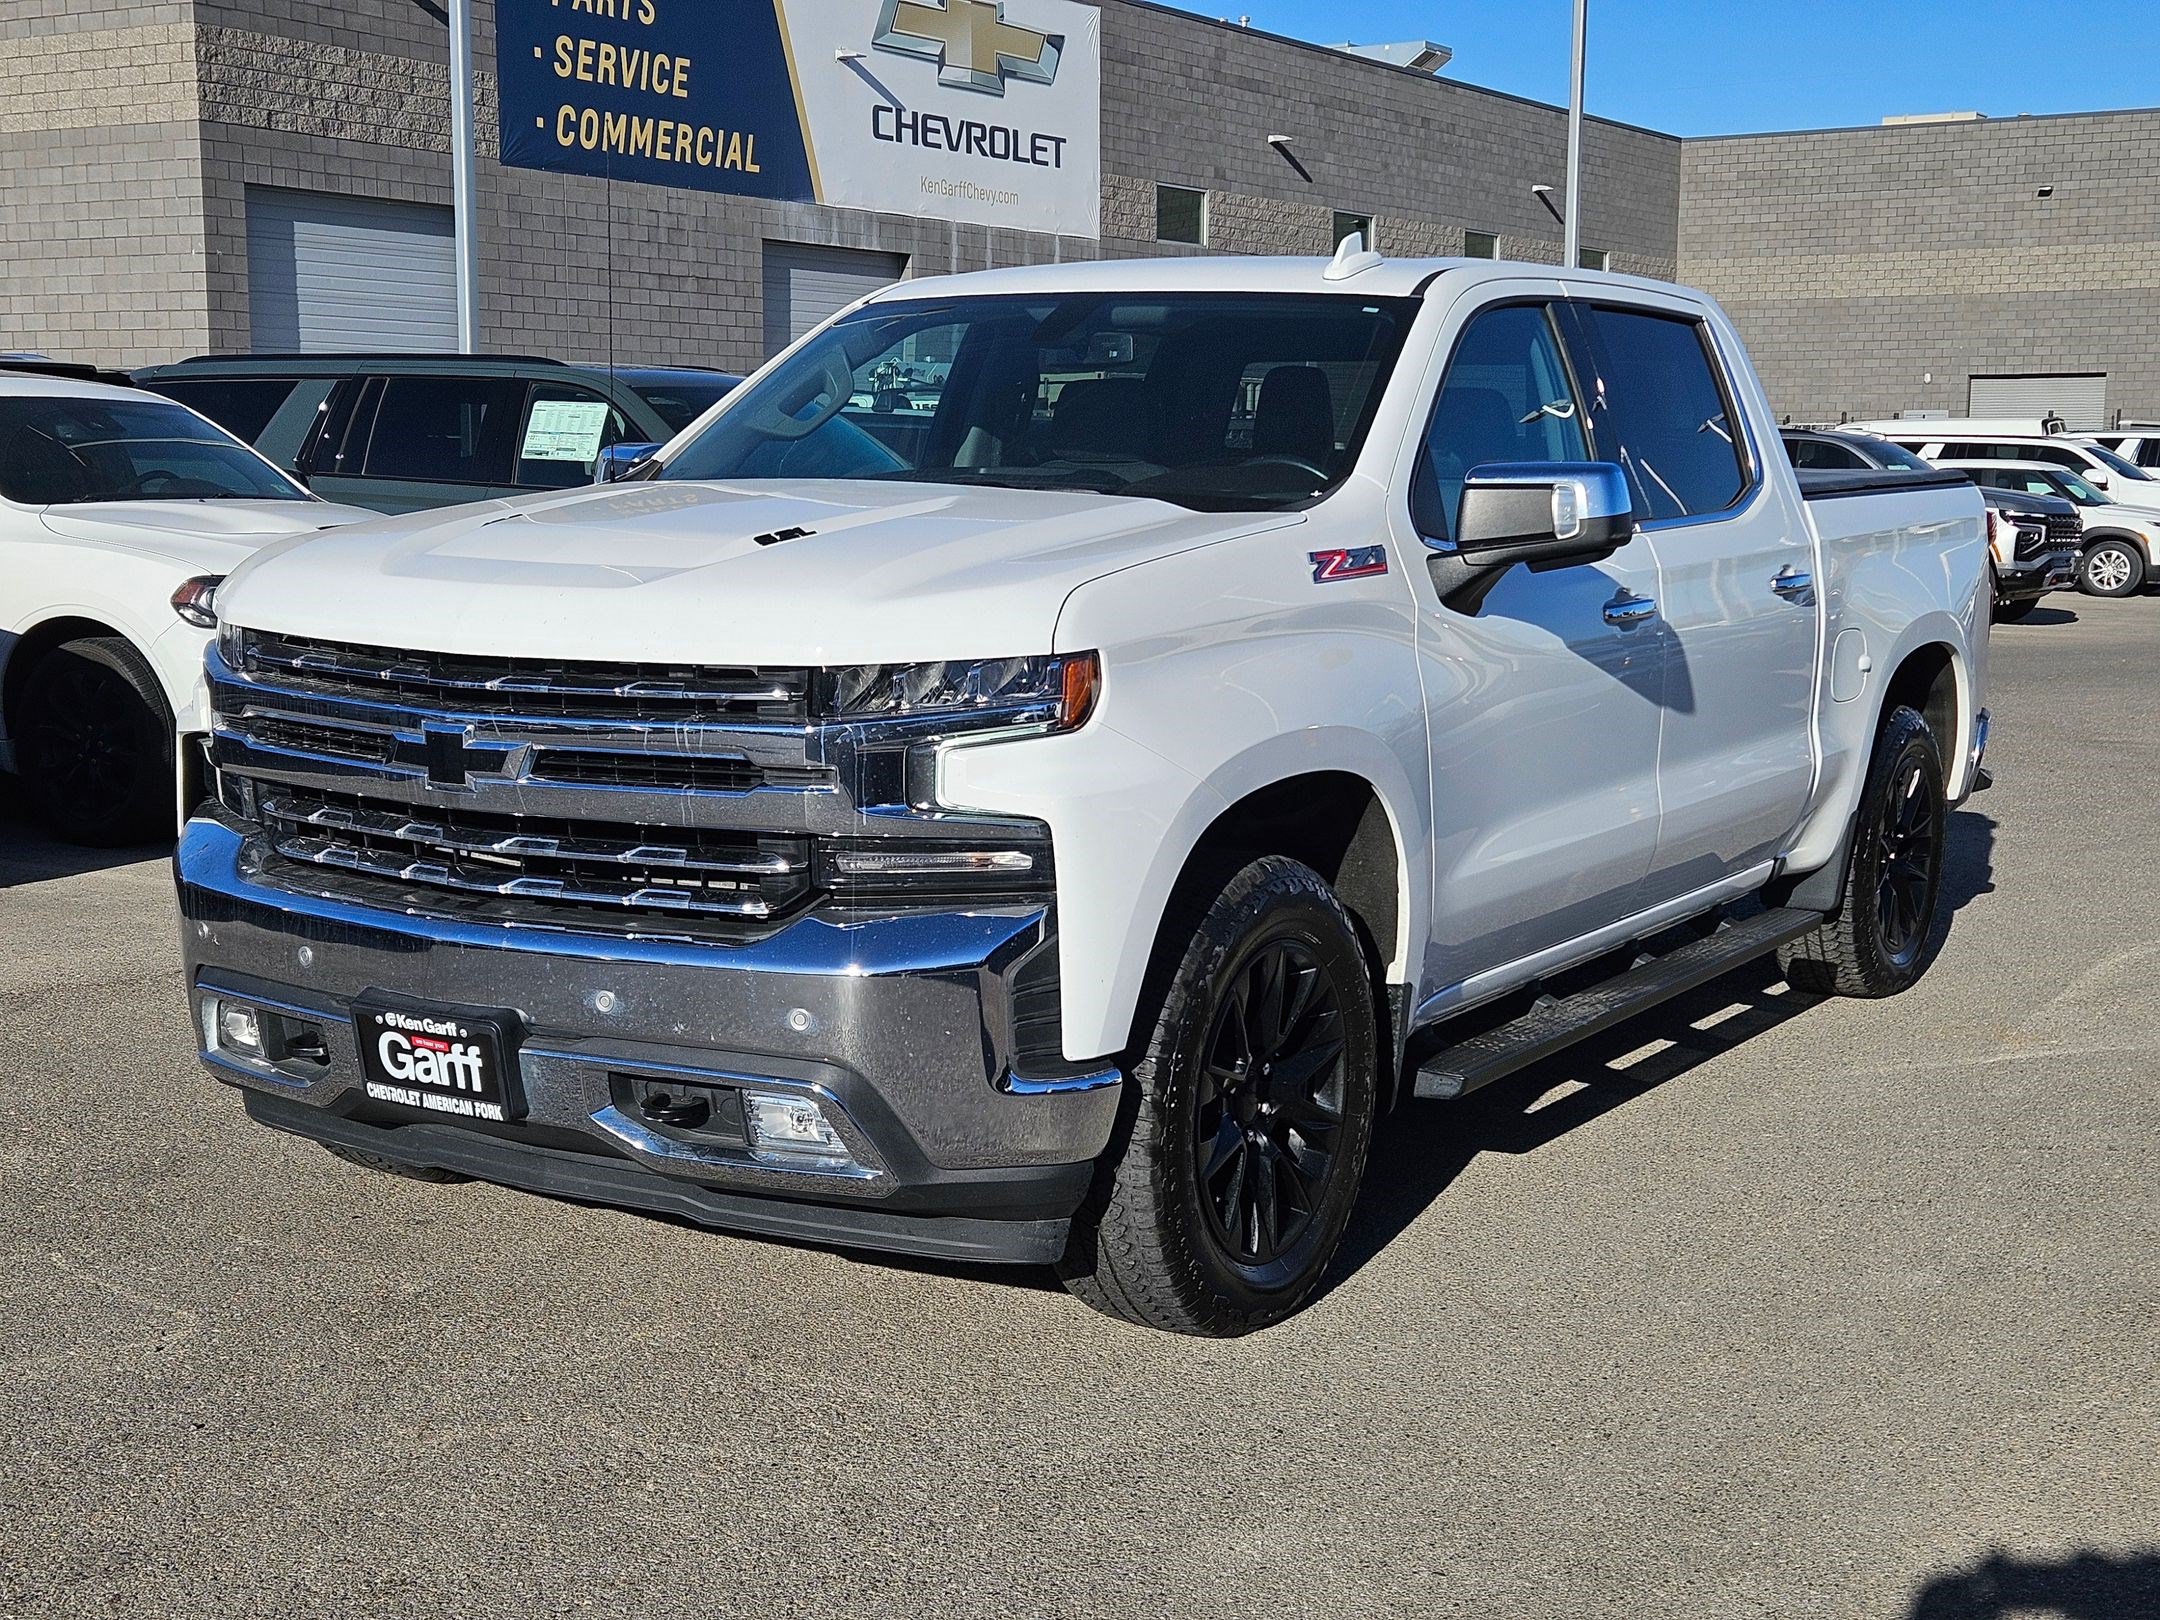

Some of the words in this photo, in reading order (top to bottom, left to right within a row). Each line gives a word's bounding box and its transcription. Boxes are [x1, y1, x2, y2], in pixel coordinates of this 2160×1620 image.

[553, 34, 691, 98] SERVICE
[556, 104, 760, 173] COMMERCIAL
[872, 104, 1067, 168] CHEVROLET
[920, 175, 1019, 206] KenGarffChevy.com
[1307, 545, 1388, 584] Z71
[378, 1031, 483, 1093] Garff
[366, 1081, 421, 1107] CHEVROLET
[422, 1092, 474, 1117] AMERICAN
[473, 1101, 504, 1121] FORK
